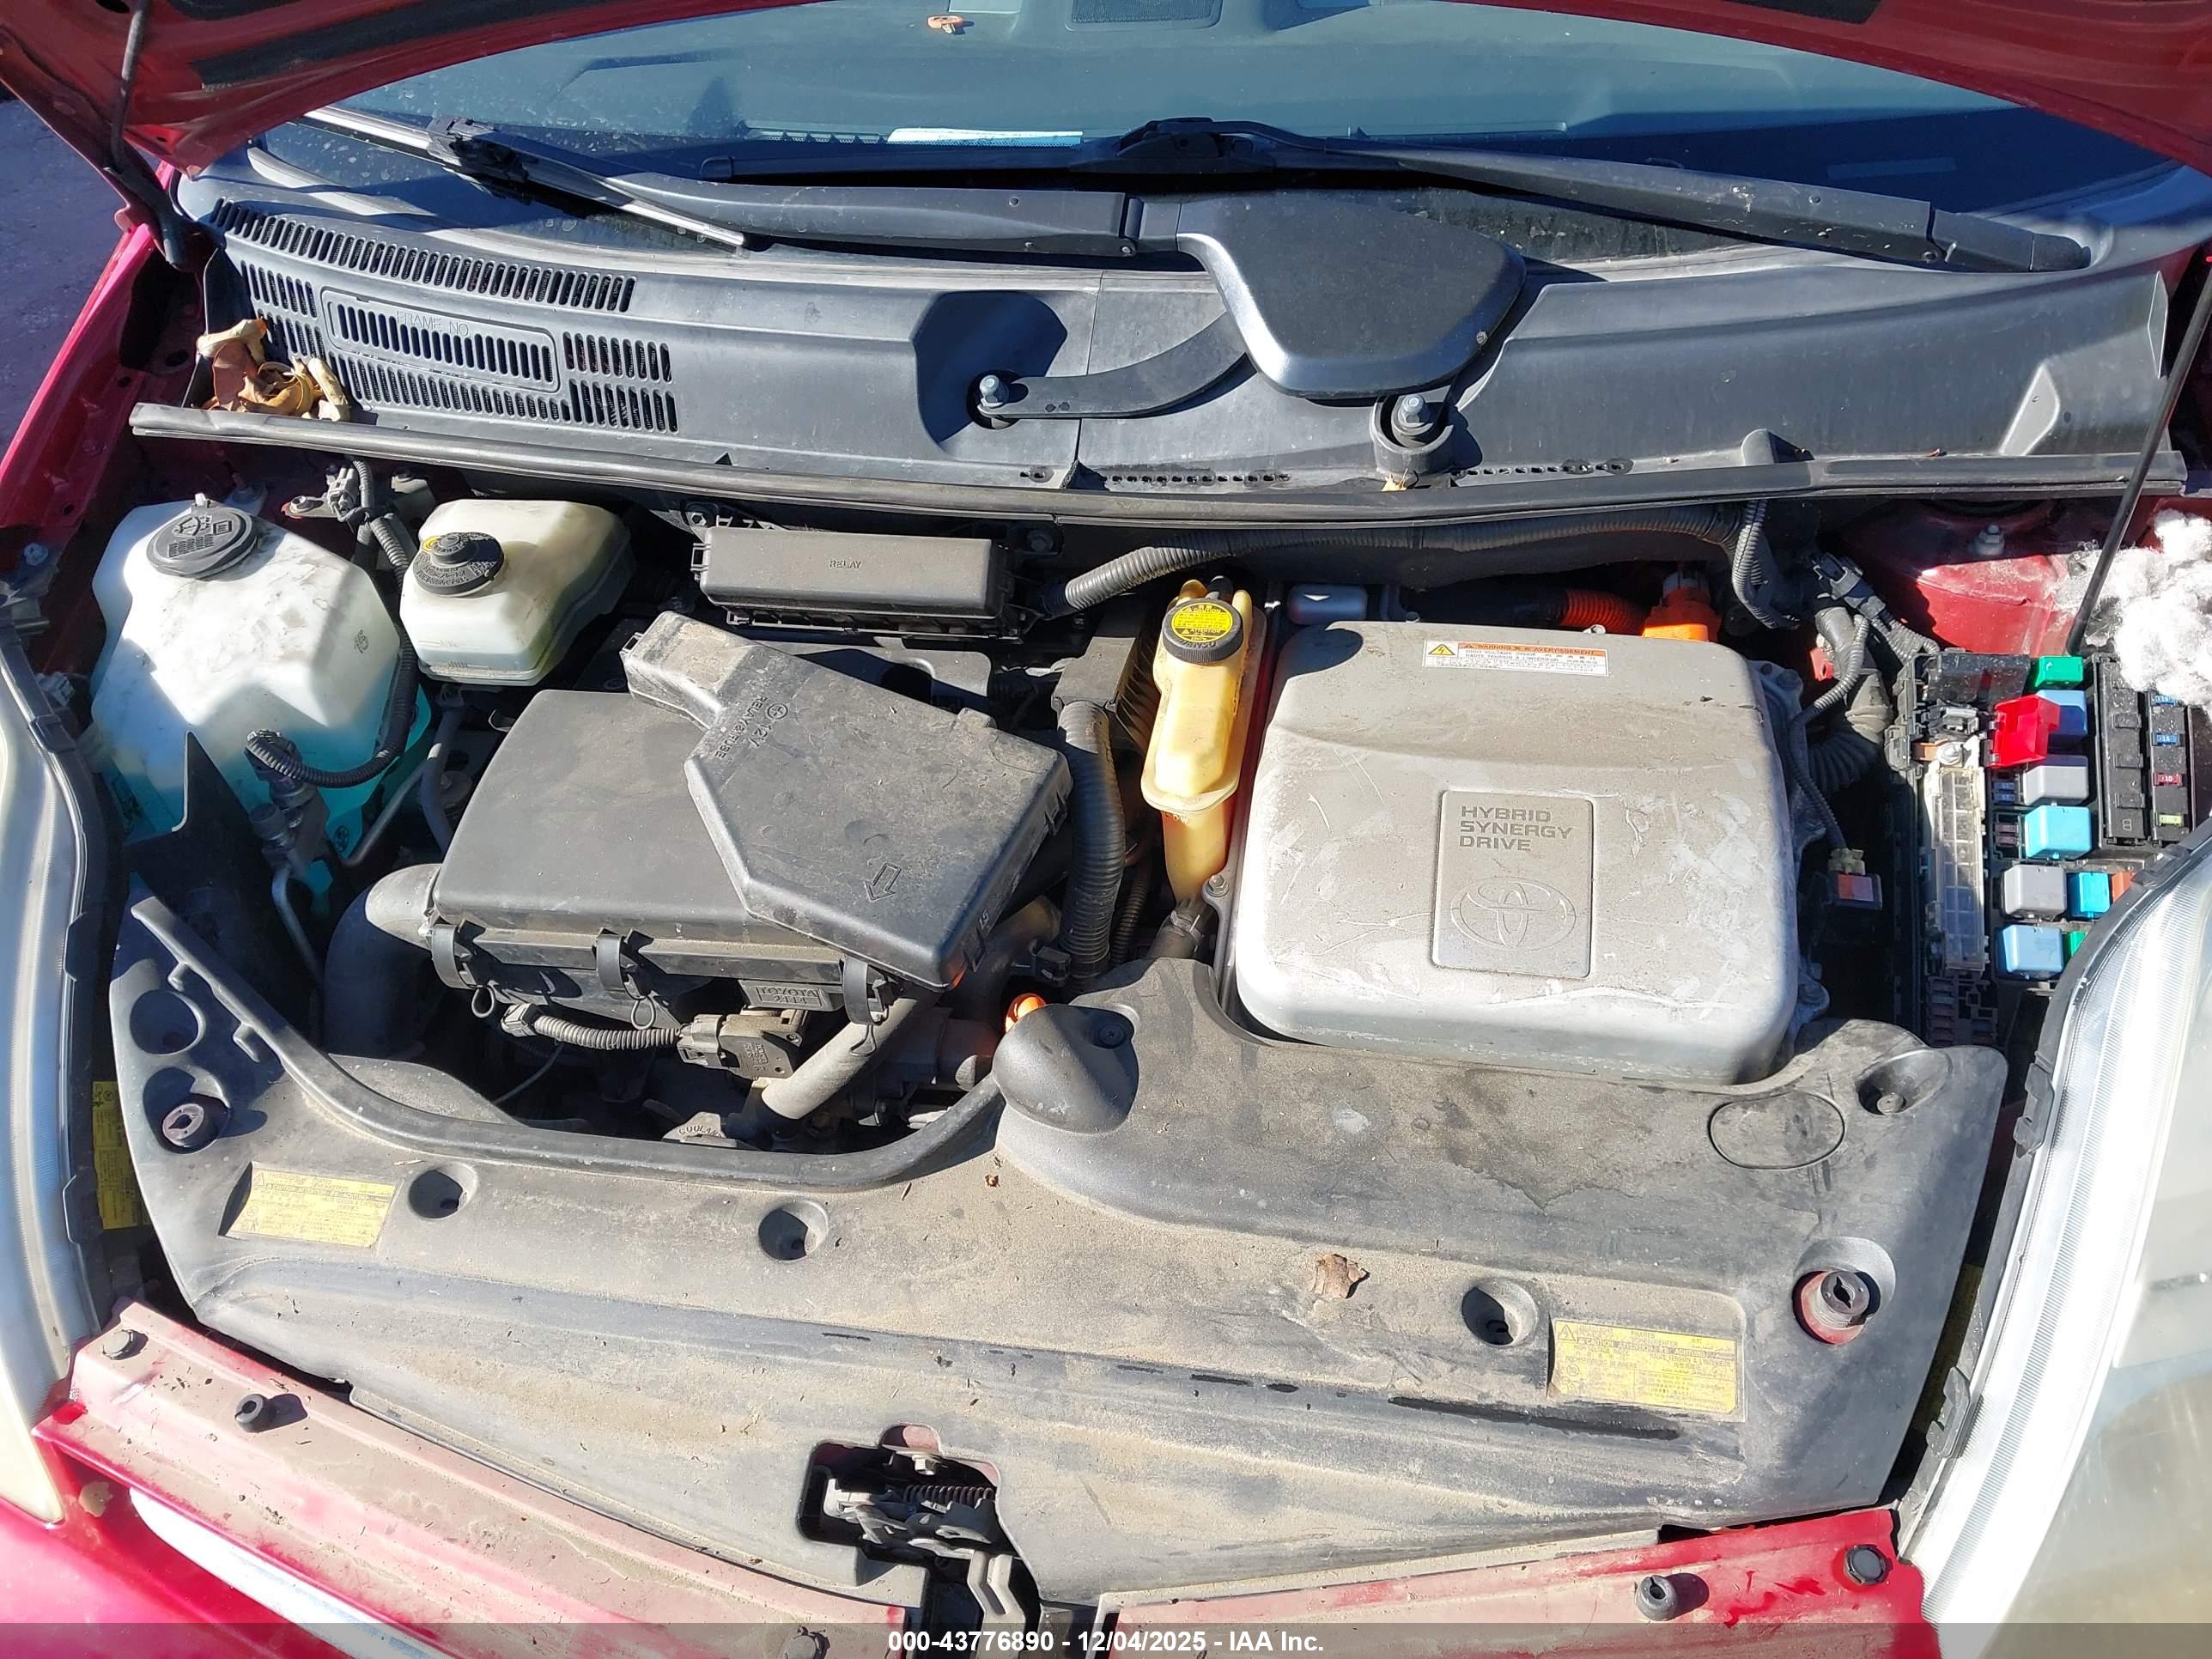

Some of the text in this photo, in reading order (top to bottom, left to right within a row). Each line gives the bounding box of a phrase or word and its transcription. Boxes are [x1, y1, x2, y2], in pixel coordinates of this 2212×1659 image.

[396, 310, 441, 331] FRAME
[830, 559, 861, 568] RELAY
[748, 723, 772, 747] 12V
[1461, 805, 1552, 823] HYBRID
[1460, 820, 1574, 839] SYNERGY
[1459, 835, 1532, 851] DRIVE
[759, 986, 817, 998] TOYOTA
